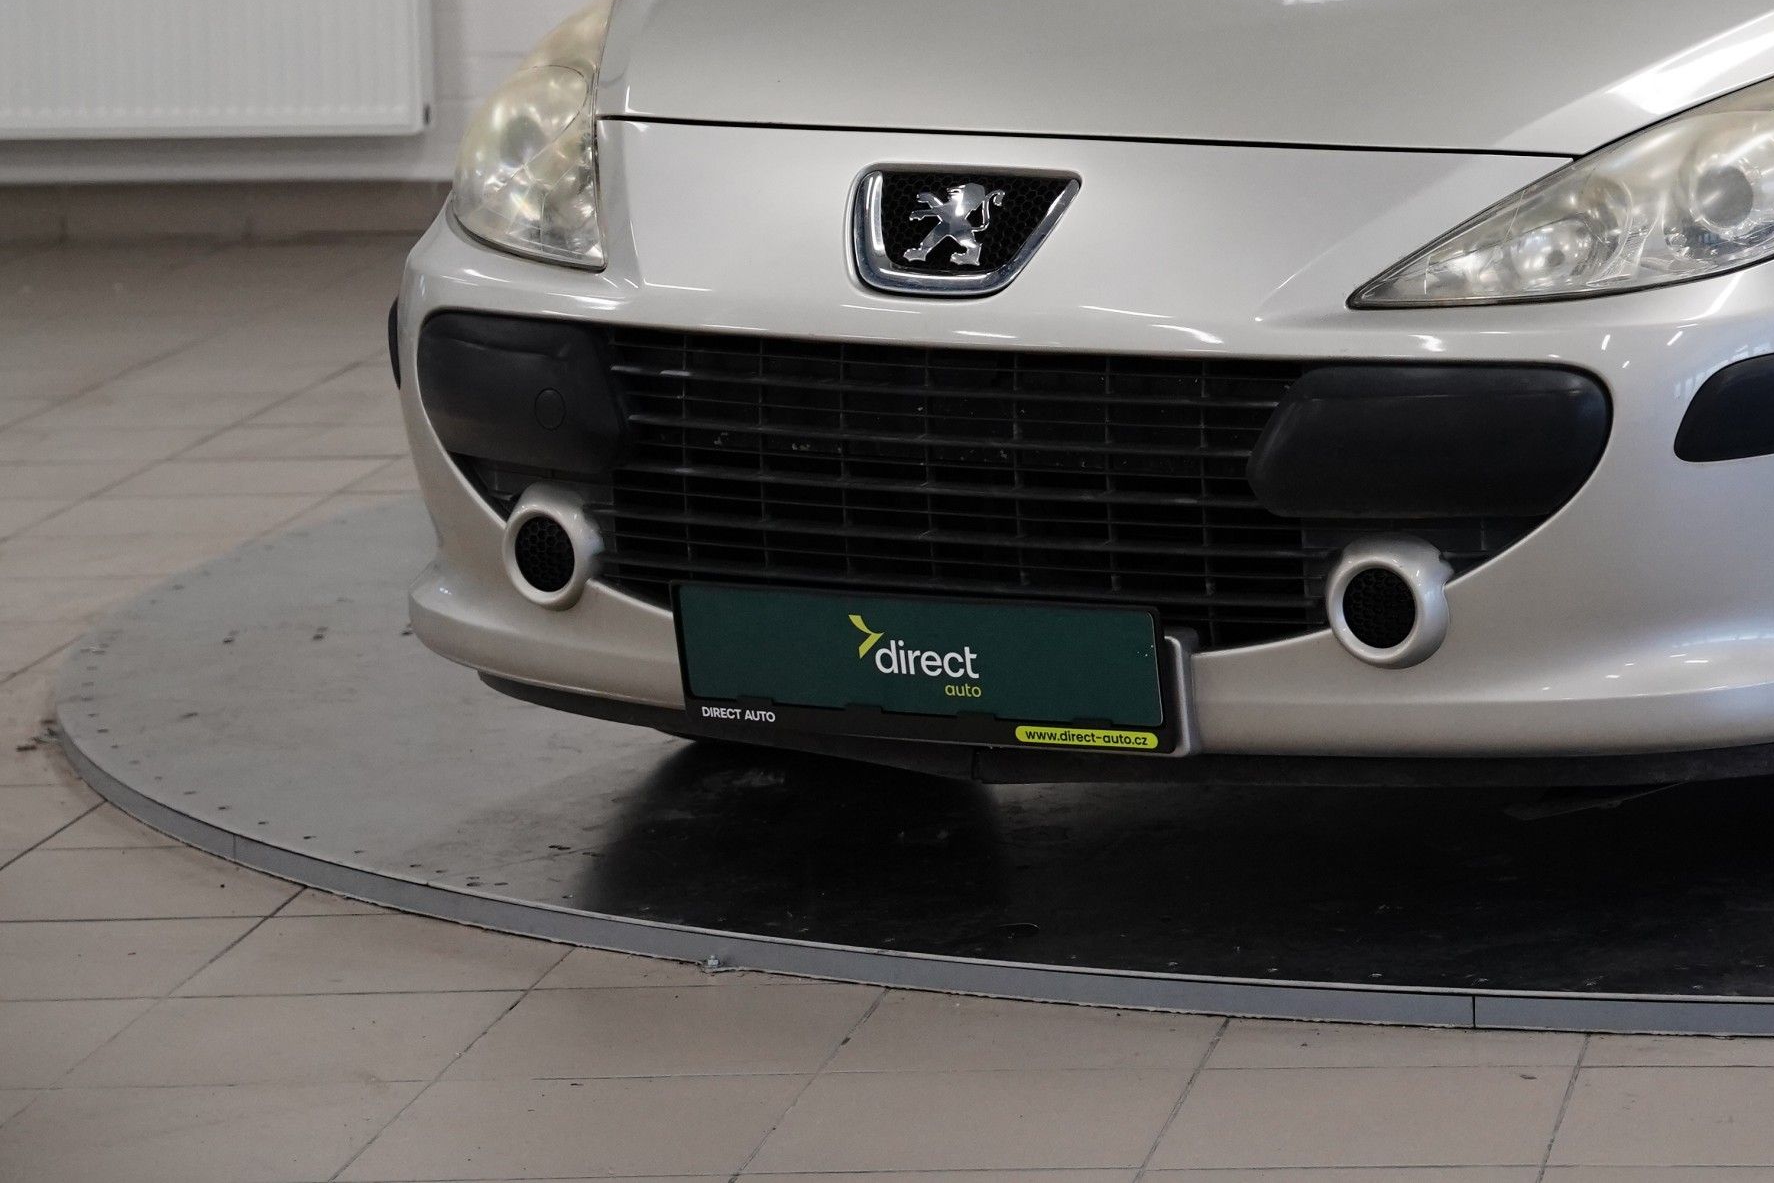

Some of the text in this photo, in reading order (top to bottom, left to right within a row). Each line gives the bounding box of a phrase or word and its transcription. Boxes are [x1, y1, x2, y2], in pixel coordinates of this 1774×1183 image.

[875, 639, 980, 679] direct
[944, 683, 982, 698] auto
[701, 706, 776, 723] DIRECT AUTO
[1025, 730, 1149, 746] www.direct-auto.cz
